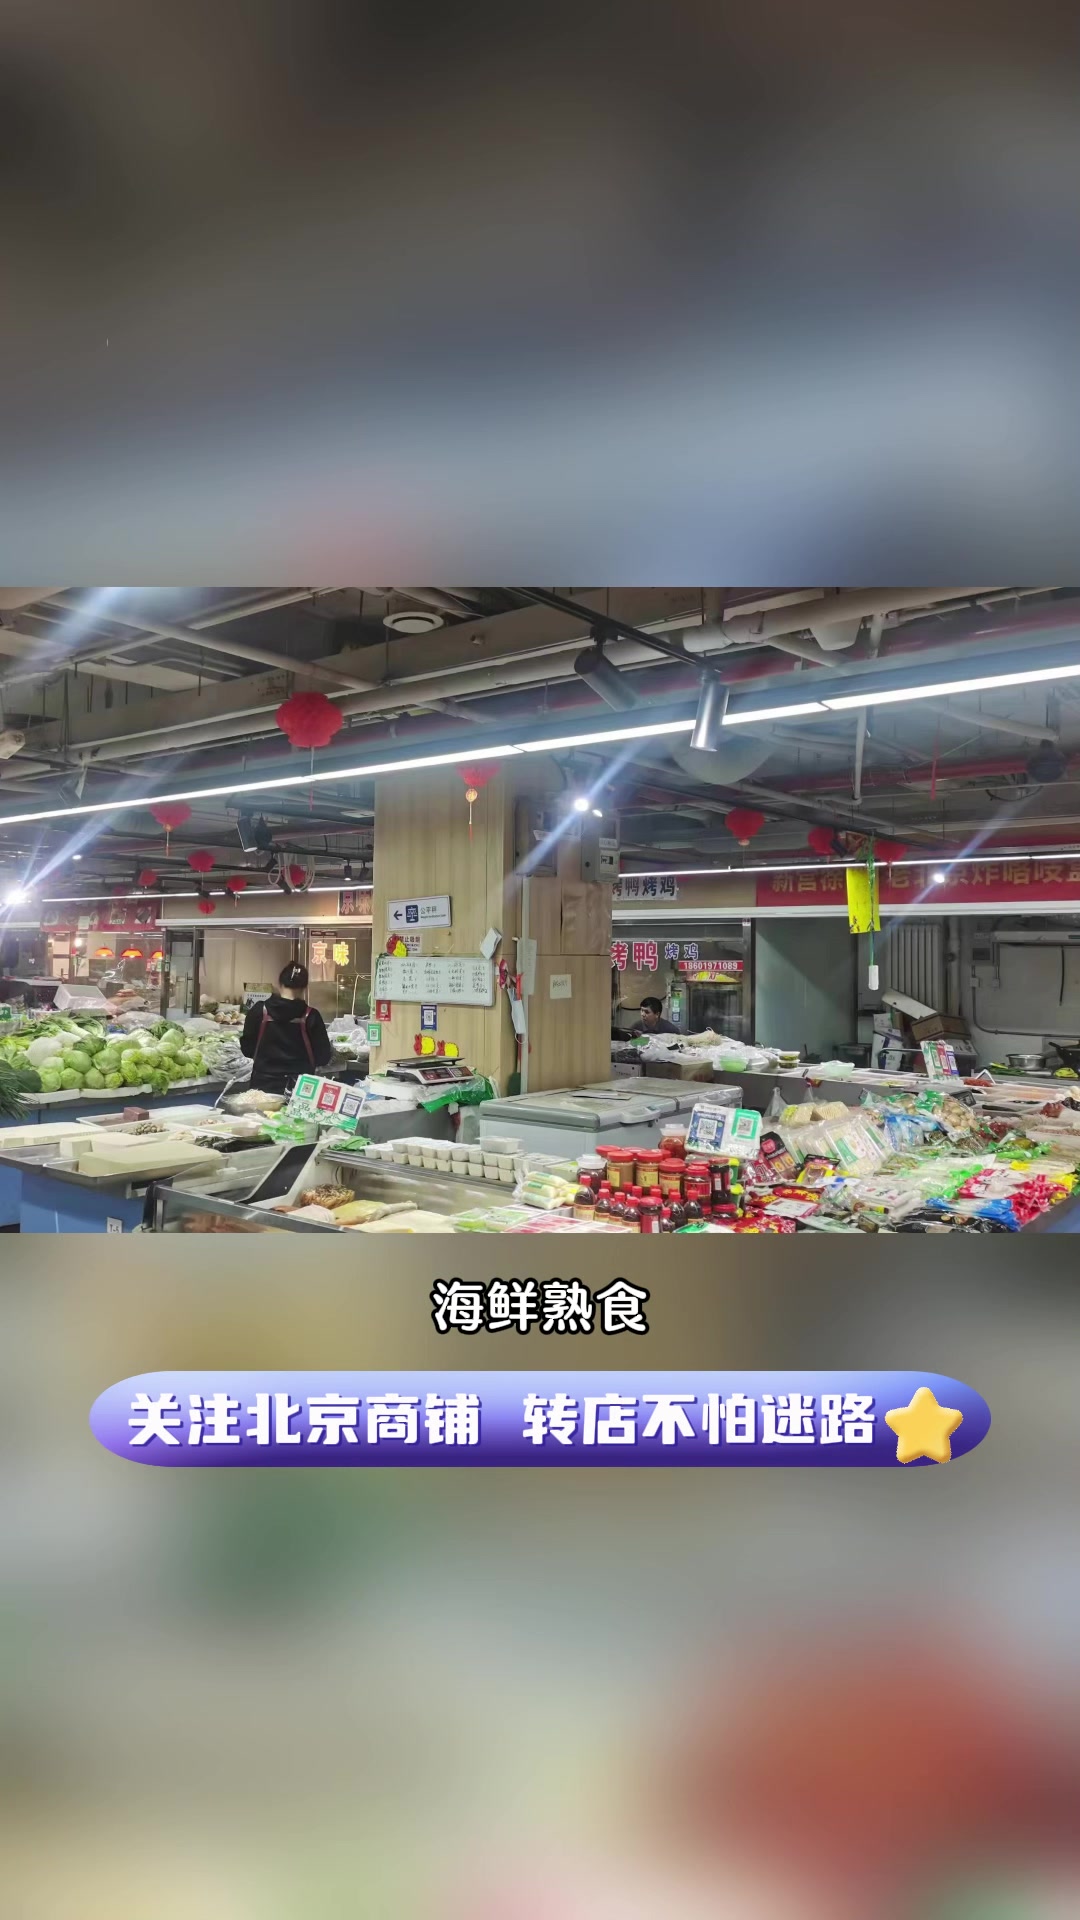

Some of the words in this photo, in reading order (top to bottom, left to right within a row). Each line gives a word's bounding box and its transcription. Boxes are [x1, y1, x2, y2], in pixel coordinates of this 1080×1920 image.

[311, 941, 350, 967] 京味
[609, 939, 659, 971] 烤鸭
[664, 942, 699, 961] 烤鸡
[683, 962, 739, 970] 18601971089
